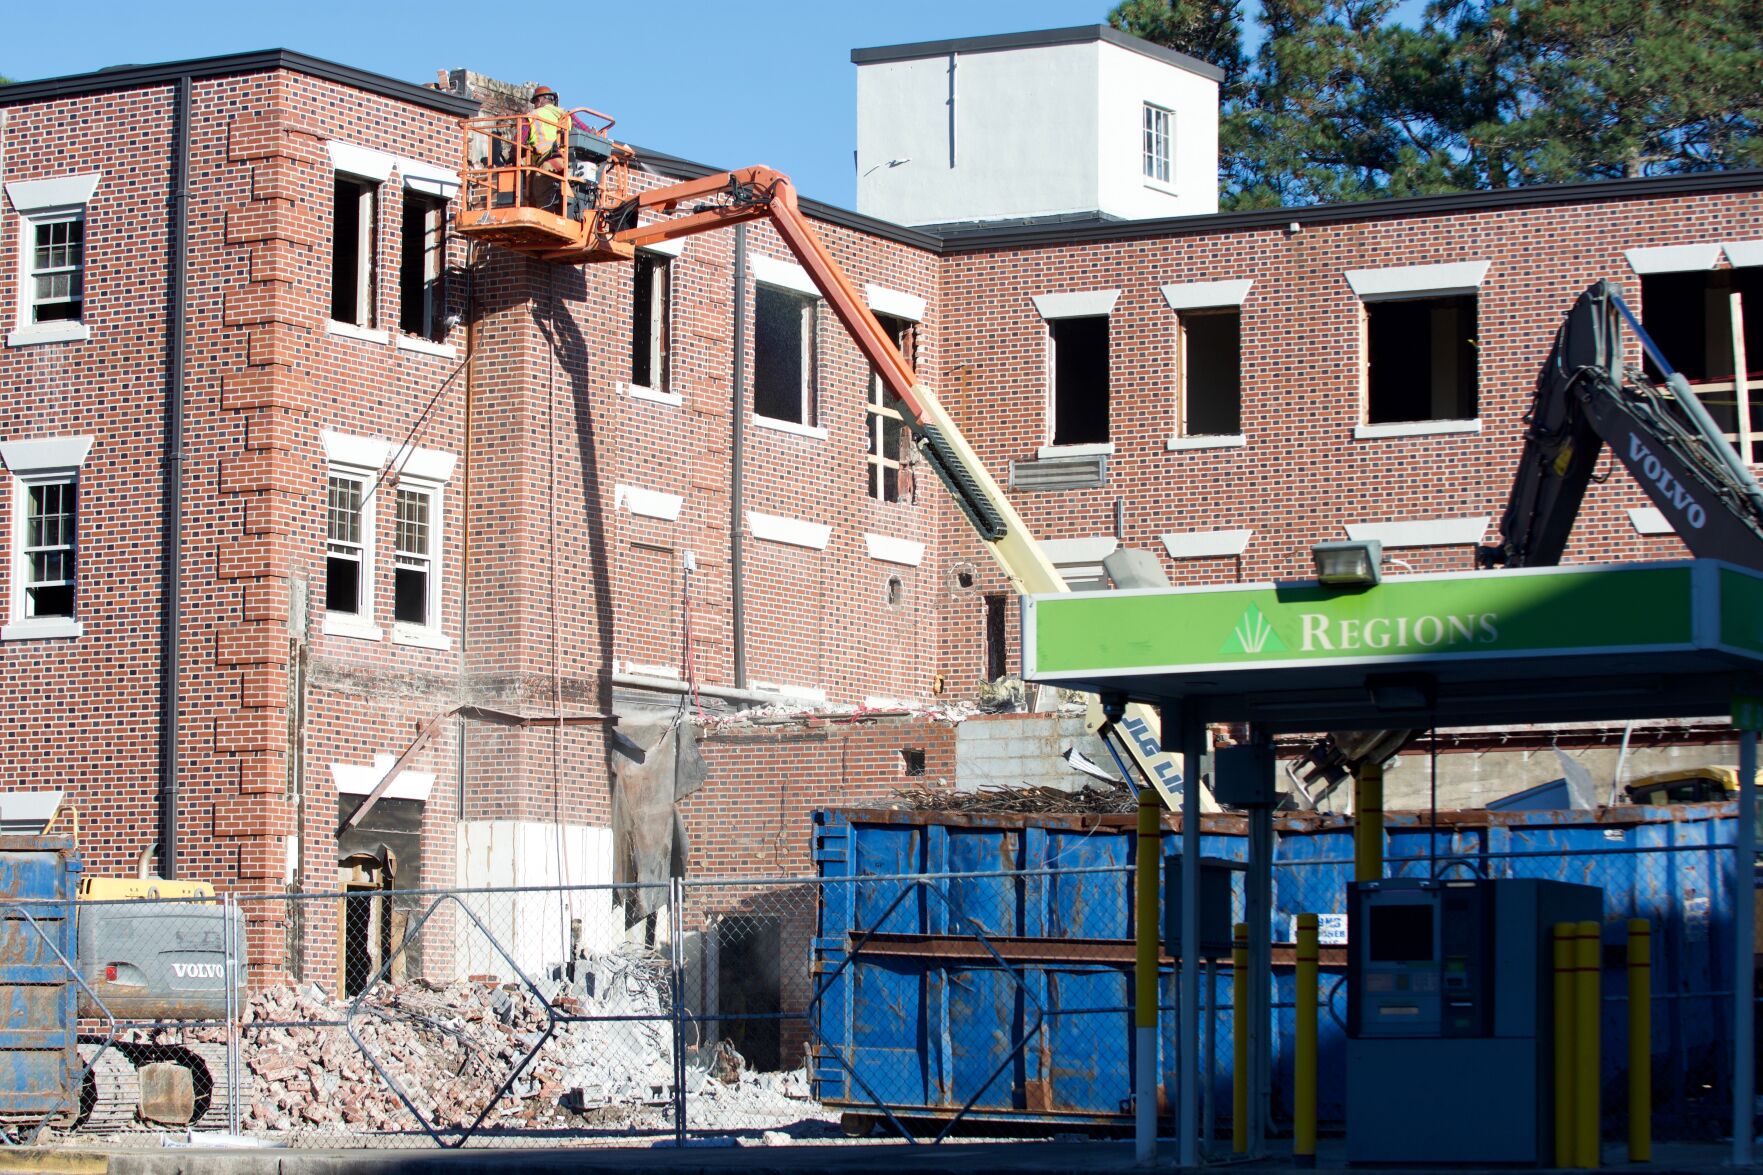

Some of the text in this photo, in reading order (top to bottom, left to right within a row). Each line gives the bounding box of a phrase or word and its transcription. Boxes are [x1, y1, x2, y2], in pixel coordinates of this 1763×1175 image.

[1628, 432, 1706, 529] VOLVO
[1299, 612, 1498, 652] REGIONS
[1121, 717, 1184, 810] JLG LIF
[171, 963, 225, 978] VOLVO
